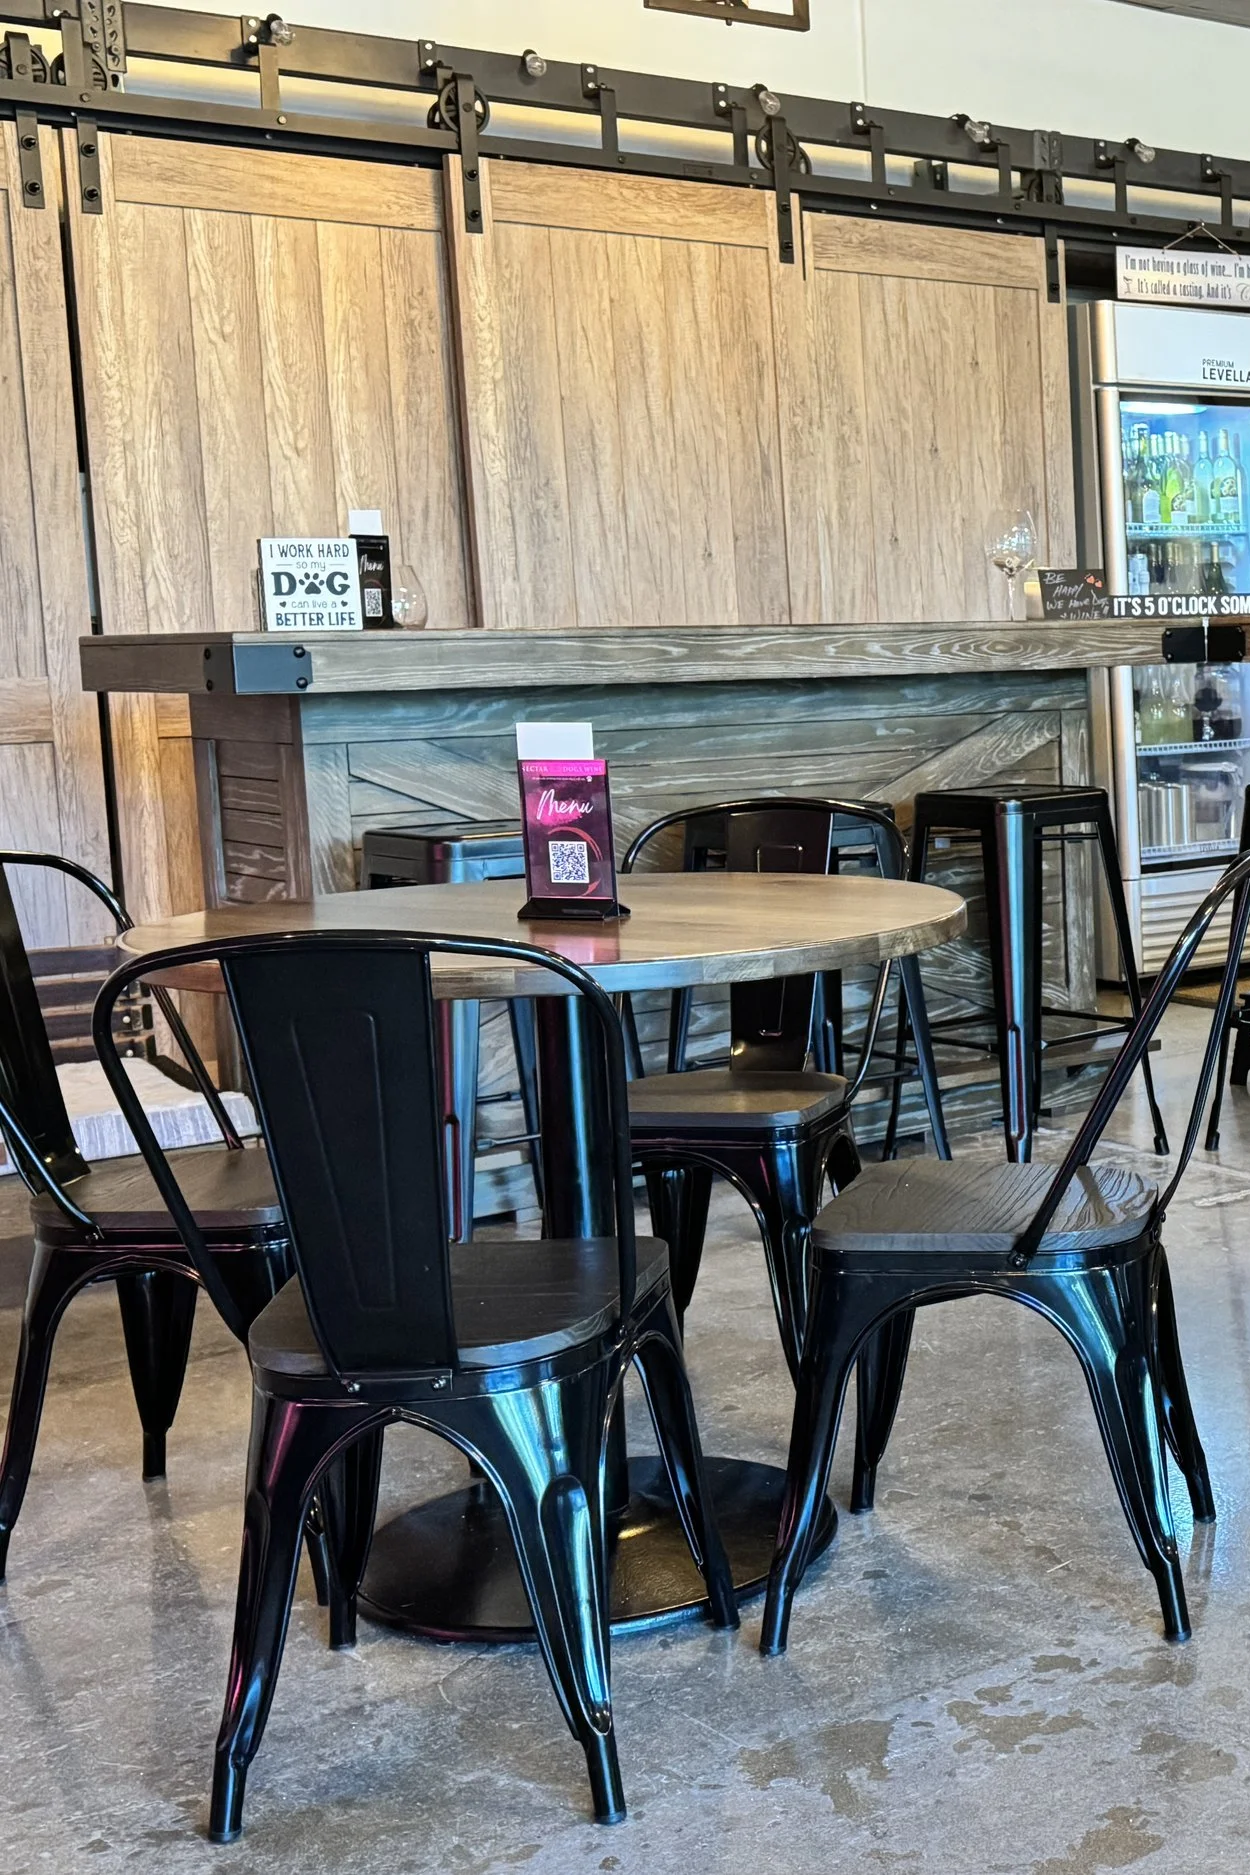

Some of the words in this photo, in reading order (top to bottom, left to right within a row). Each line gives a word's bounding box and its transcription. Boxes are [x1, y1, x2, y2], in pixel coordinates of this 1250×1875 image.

[1125, 254, 1136, 270] I'm
[1139, 258, 1150, 271] not
[1152, 256, 1174, 275] having
[1176, 262, 1181, 273] a
[1183, 259, 1199, 276] glass
[1201, 260, 1208, 277] of
[1234, 263, 1244, 278] I'm
[1137, 278, 1149, 294] It's
[1150, 280, 1171, 296] called
[1173, 284, 1177, 295] a
[1207, 283, 1219, 298] And
[1221, 284, 1232, 299] it's
[1202, 358, 1235, 368] PREMIUM
[270, 544, 273, 558] I
[277, 544, 313, 558] WORK
[318, 544, 349, 558] HARD
[296, 561, 307, 569] so
[310, 561, 326, 572] my
[1043, 572, 1066, 584] BE
[1052, 583, 1084, 598] HAPPY
[312, 600, 327, 608] live
[1046, 599, 1064, 611] WE
[1113, 597, 1141, 616] IT'S
[1144, 597, 1155, 615] 5
[1158, 596, 1218, 615] O'CLOCK
[276, 612, 324, 626] BETTER
[328, 612, 356, 626] LIFE
[536, 789, 593, 820] Menu
